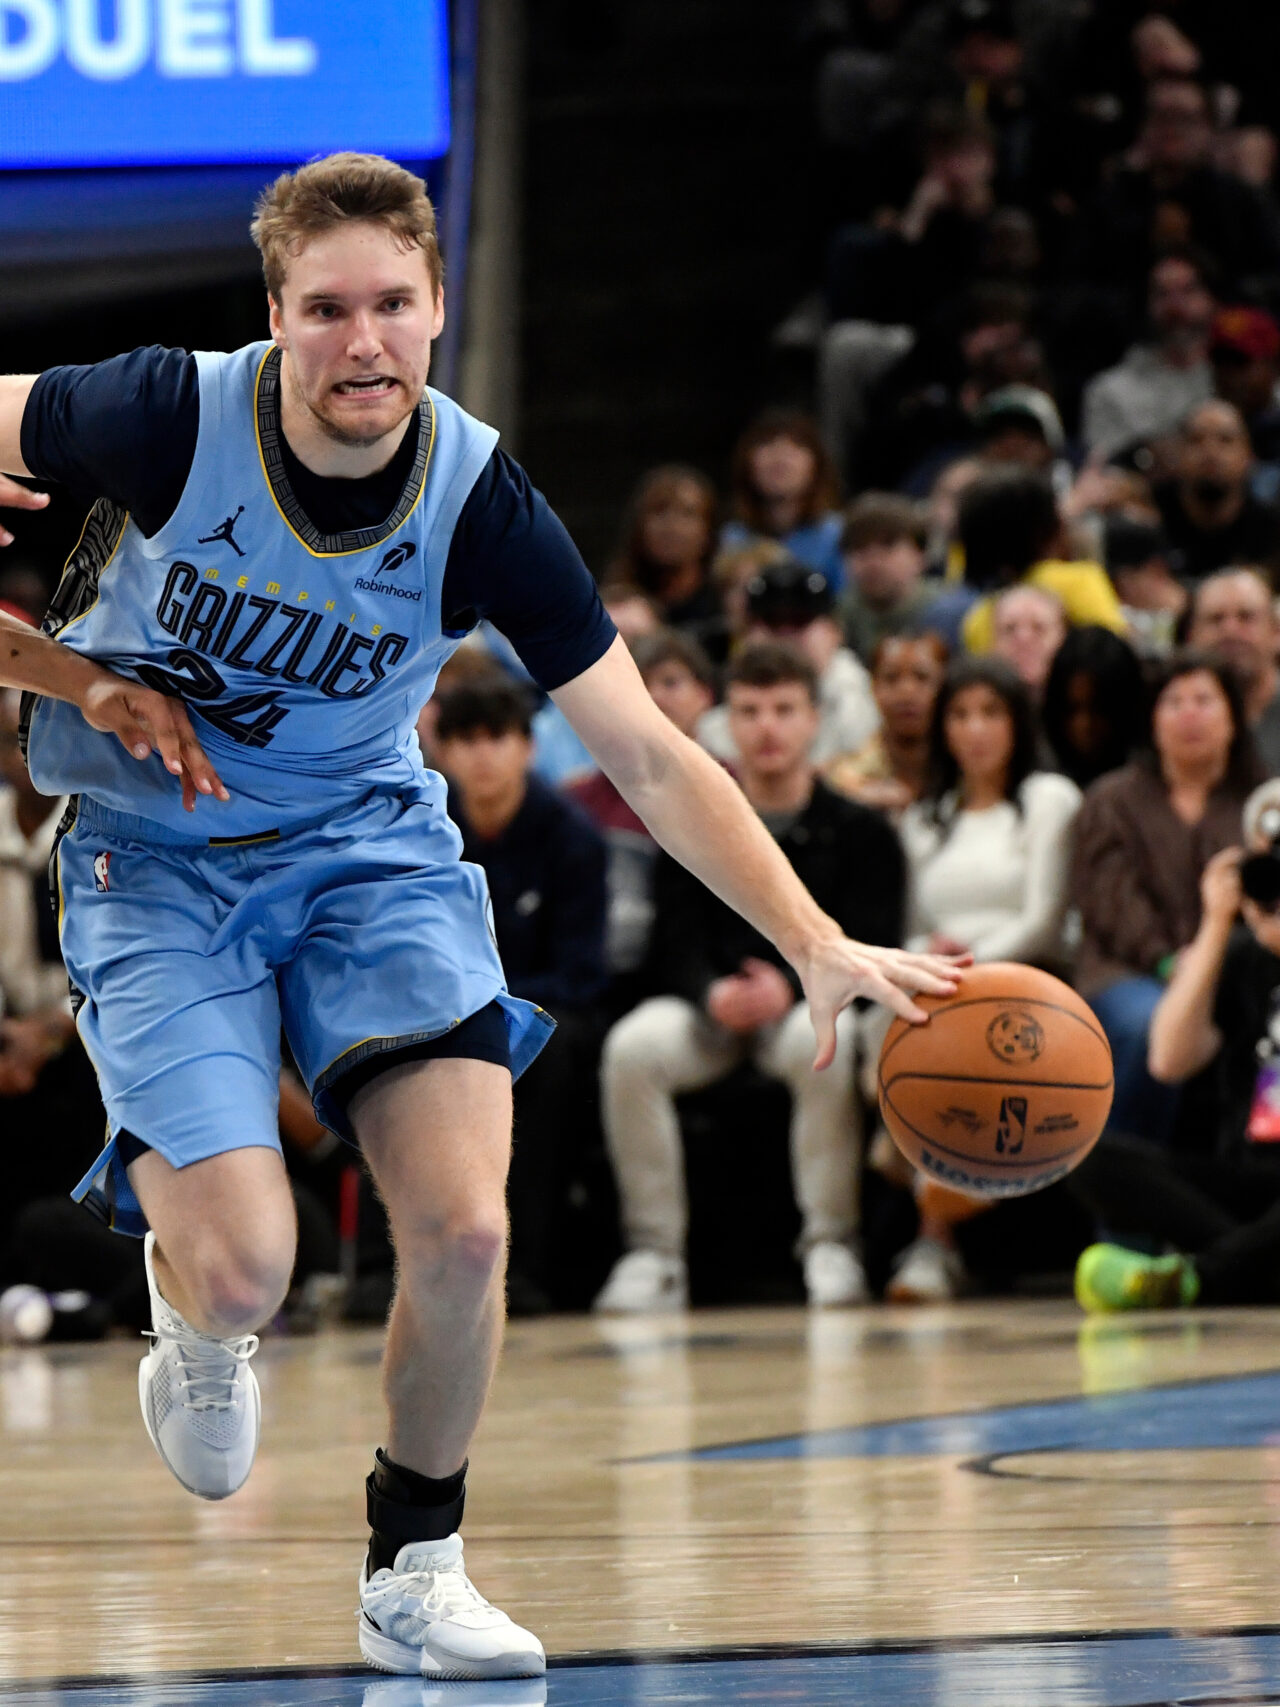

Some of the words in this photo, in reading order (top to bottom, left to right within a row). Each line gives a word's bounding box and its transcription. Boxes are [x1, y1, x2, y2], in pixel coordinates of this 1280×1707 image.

[157, 561, 409, 697] GRIZZLIES
[204, 568, 383, 636] MEMPHIS
[353, 578, 422, 602] Robinhood
[132, 648, 291, 749] 24
